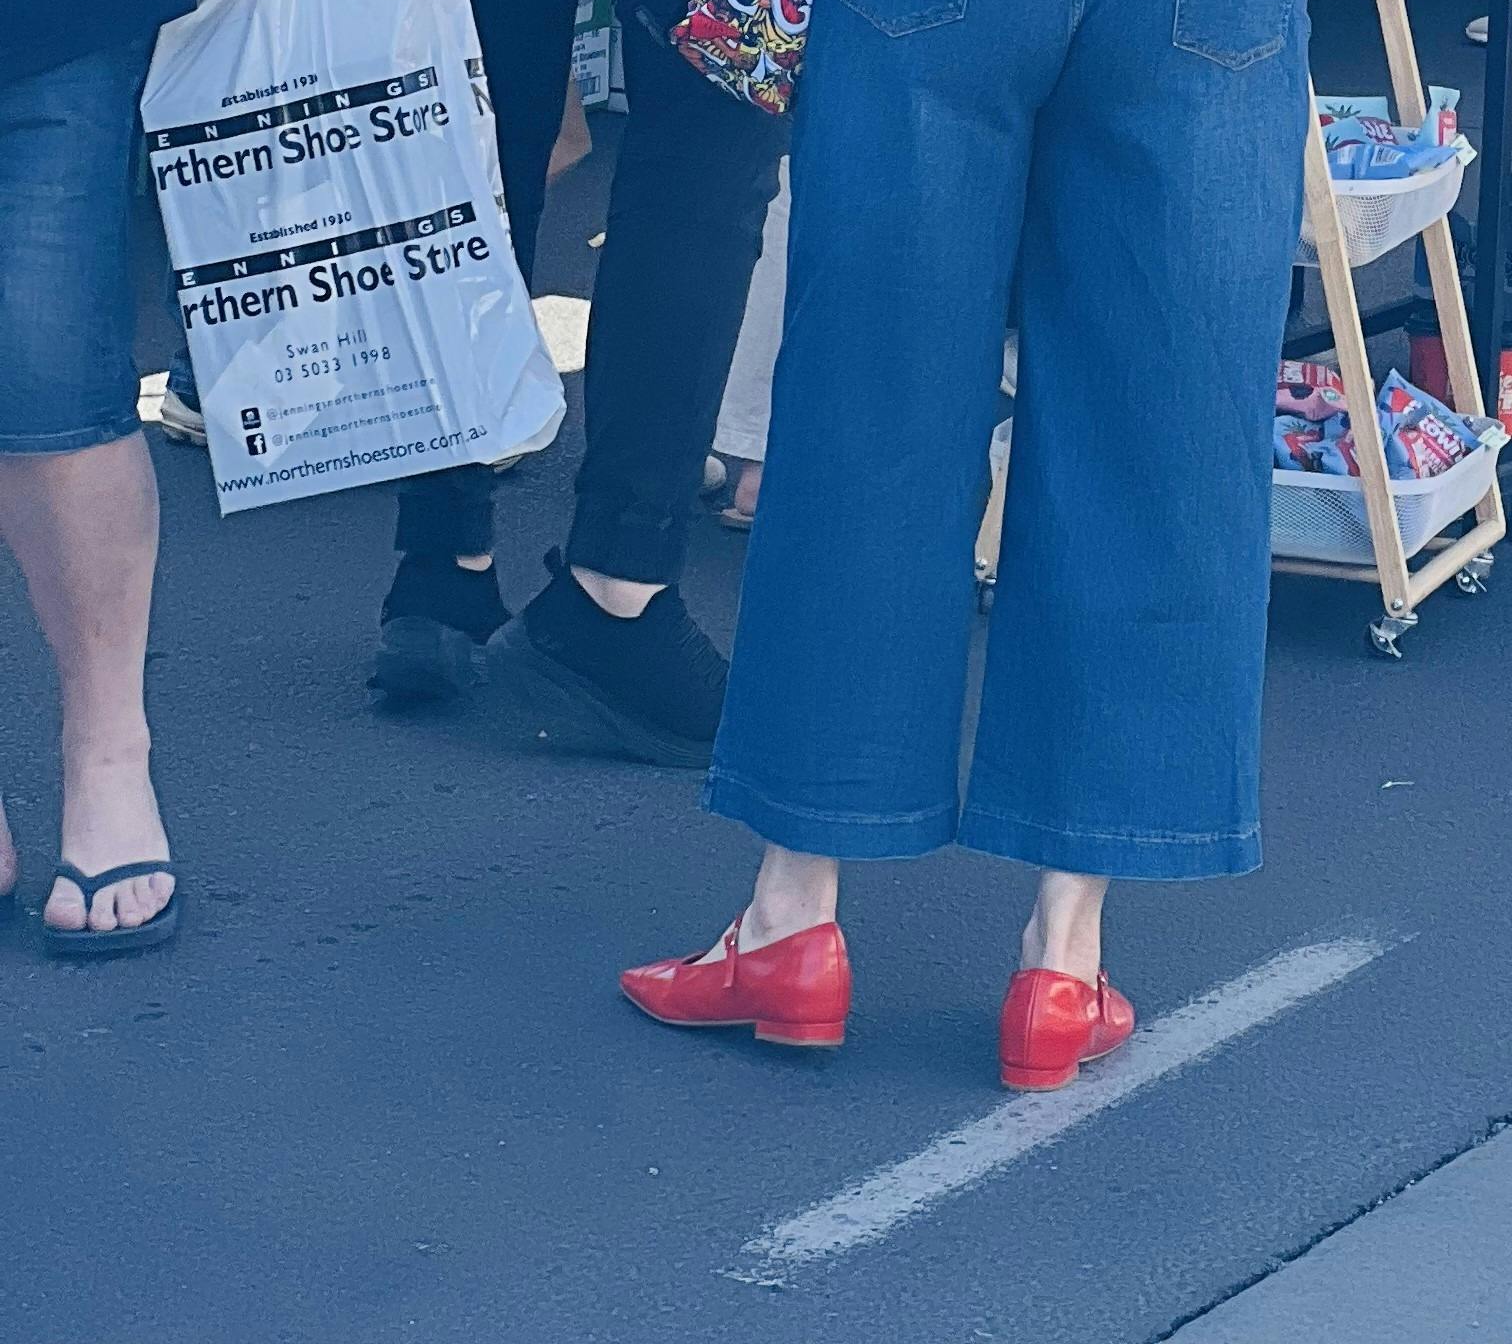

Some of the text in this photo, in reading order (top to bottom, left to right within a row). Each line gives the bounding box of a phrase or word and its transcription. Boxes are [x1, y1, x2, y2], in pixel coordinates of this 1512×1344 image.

[278, 122, 362, 164] Shoe
[369, 100, 450, 143] Store
[249, 217, 319, 244] Established
[308, 261, 396, 303] Shoe
[286, 327, 368, 360] Swan Hill
[274, 346, 391, 384] 03 5033 1998
[218, 423, 489, 494] www.northernshoestore.com.au
